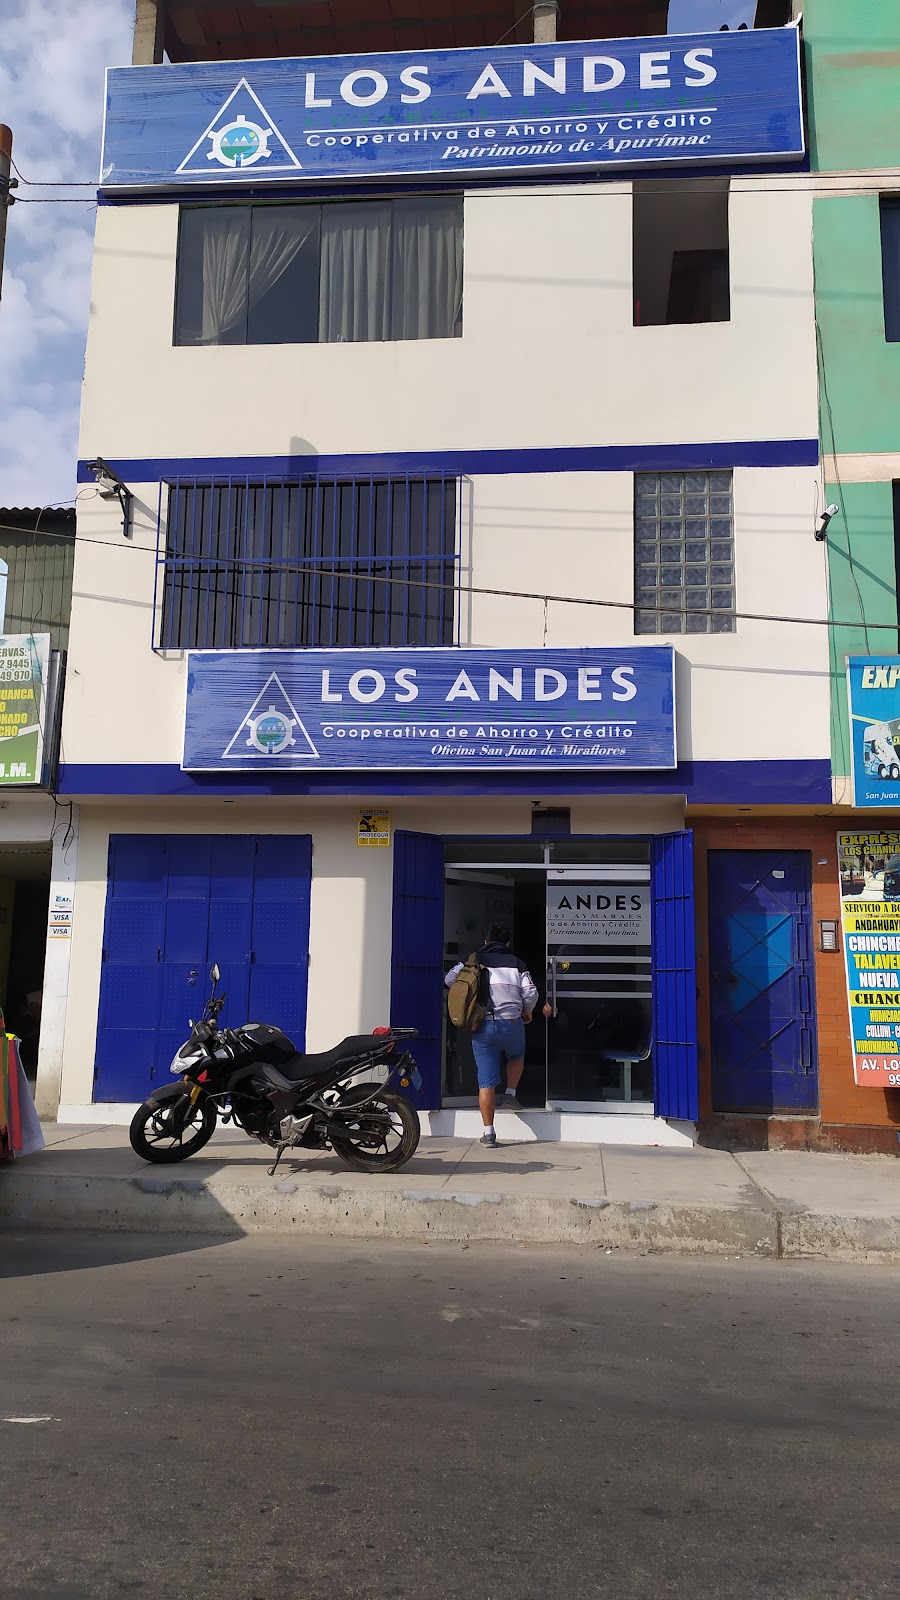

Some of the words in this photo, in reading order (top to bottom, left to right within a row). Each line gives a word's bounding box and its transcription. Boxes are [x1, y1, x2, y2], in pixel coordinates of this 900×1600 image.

[305, 65, 432, 108] LOS
[466, 48, 717, 99] ANDES
[306, 128, 458, 147] Cooperativa
[467, 127, 496, 138] de
[505, 122, 588, 136] Ahorro
[597, 122, 609, 134] y
[617, 114, 712, 130] Crédito
[440, 140, 563, 159] Patrimonio
[568, 138, 595, 152] de
[597, 134, 711, 153] Apurímac
[0, 648, 27, 657] RVAS:
[7, 659, 29, 668] 9445
[14, 670, 30, 680] 970
[862, 666, 900, 688] EXP
[321, 668, 419, 703] LOS
[445, 666, 637, 702] ANDES
[0, 689, 34, 700] UANCA
[322, 726, 439, 740] Cooperativa
[446, 726, 469, 738] de
[475, 726, 538, 737] Ahorro
[545, 728, 554, 740] y
[561, 725, 633, 737] Crédito
[431, 744, 476, 756] Oficina
[479, 745, 503, 756] San
[505, 744, 539, 757] Juan
[541, 745, 556, 756] de
[559, 744, 626, 756] Miraflores
[881, 792, 898, 800] Juan
[840, 833, 900, 845] EXPRES
[844, 845, 861, 856] LOS
[557, 894, 642, 911] ANDES
[844, 903, 881, 912] SERVICIO
[884, 904, 889, 912] A
[855, 919, 900, 931] ANDAHUAY
[848, 935, 900, 952] CHINCHE
[859, 972, 899, 988] NUEVA
[861, 1059, 880, 1070] AV.
[883, 1059, 900, 1071] LO
